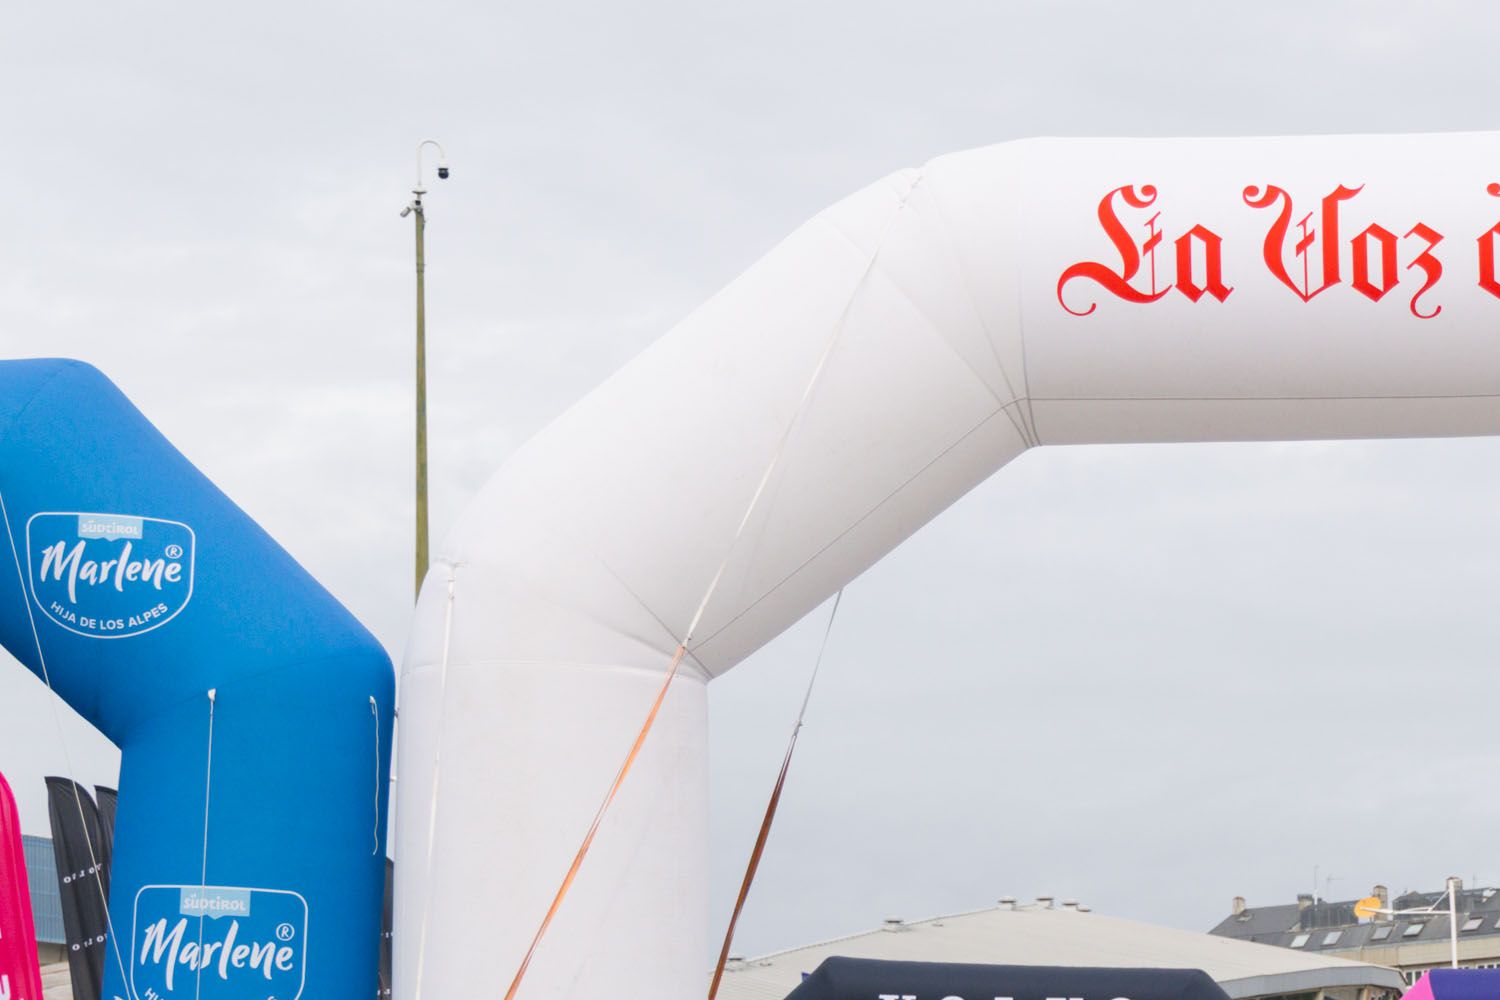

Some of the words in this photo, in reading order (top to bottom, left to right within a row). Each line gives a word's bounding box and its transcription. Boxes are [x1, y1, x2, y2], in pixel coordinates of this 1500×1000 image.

[1056, 183, 1234, 317] La
[1242, 182, 1446, 320] Voz
[51, 601, 76, 624] HIJA
[80, 618, 97, 630] DE
[100, 619, 124, 630] LOS
[128, 602, 168, 628] ALPES
